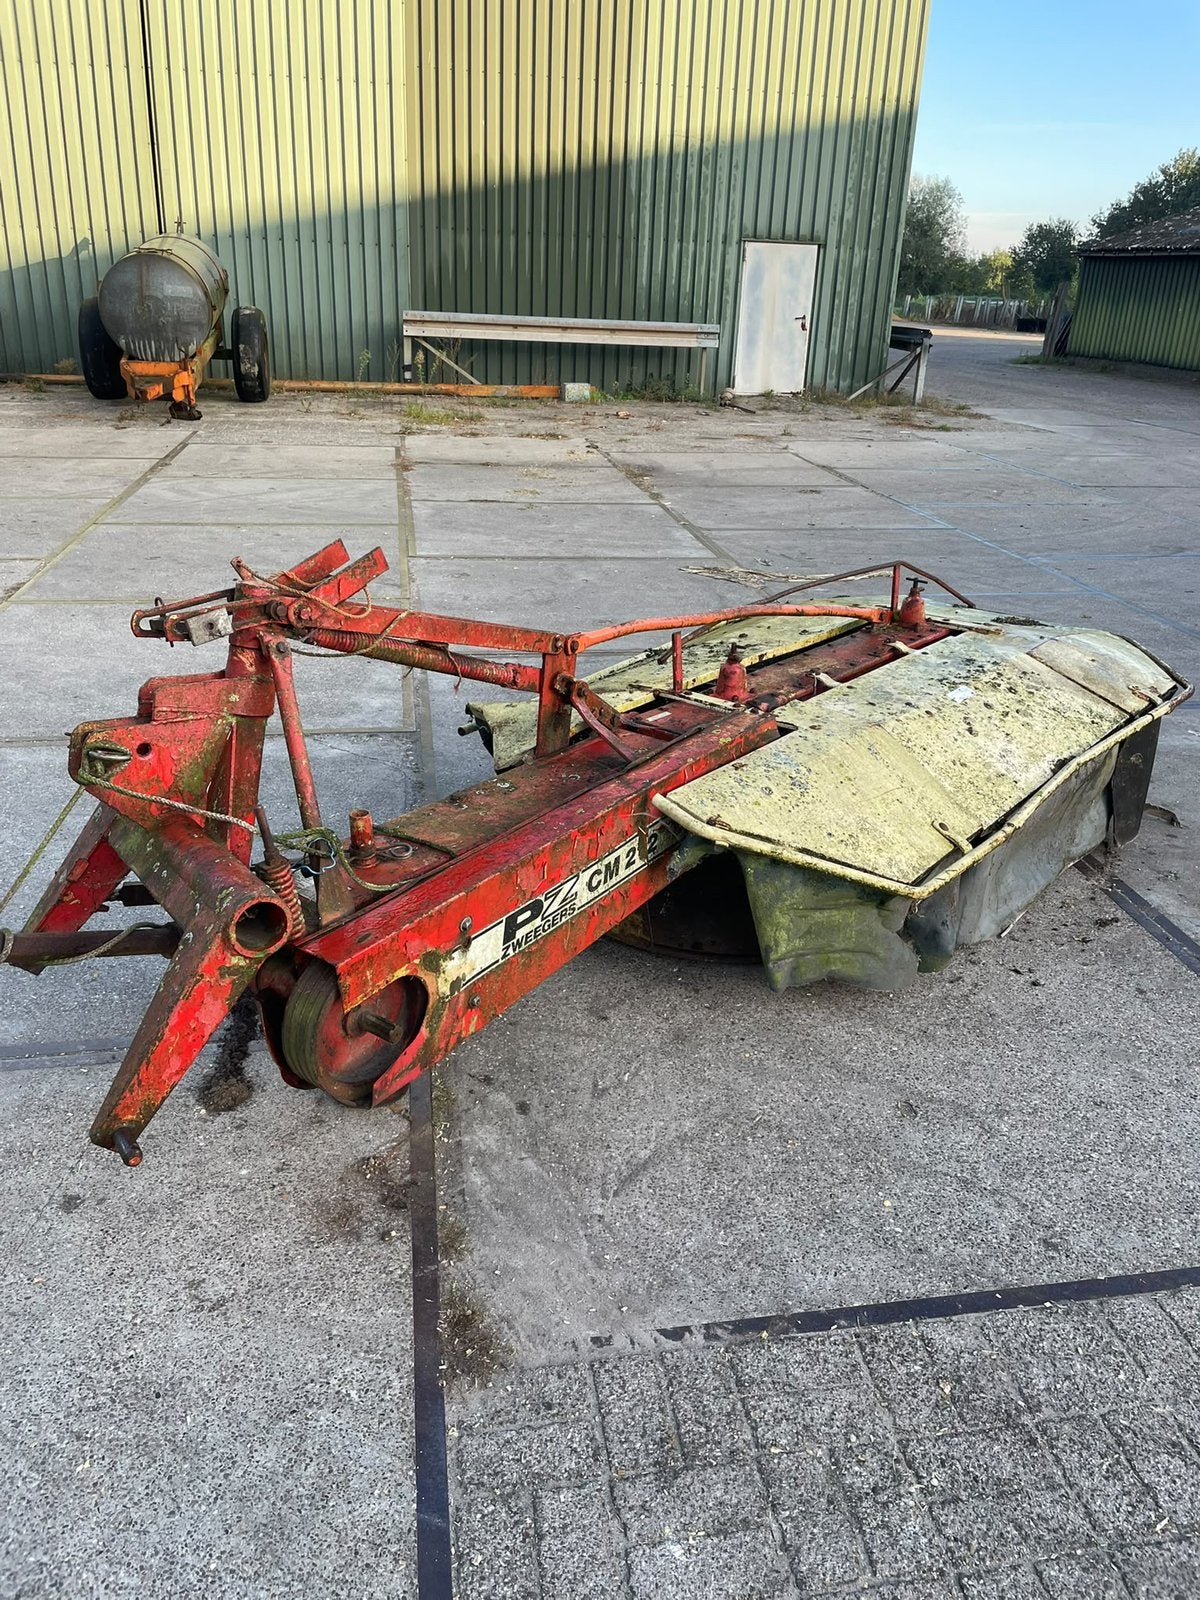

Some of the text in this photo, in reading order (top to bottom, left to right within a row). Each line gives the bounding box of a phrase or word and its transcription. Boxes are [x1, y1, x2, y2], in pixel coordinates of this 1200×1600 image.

[501, 902, 577, 960] ZWEEGERS
[503, 872, 580, 946] PZ
[587, 855, 621, 892] CM
